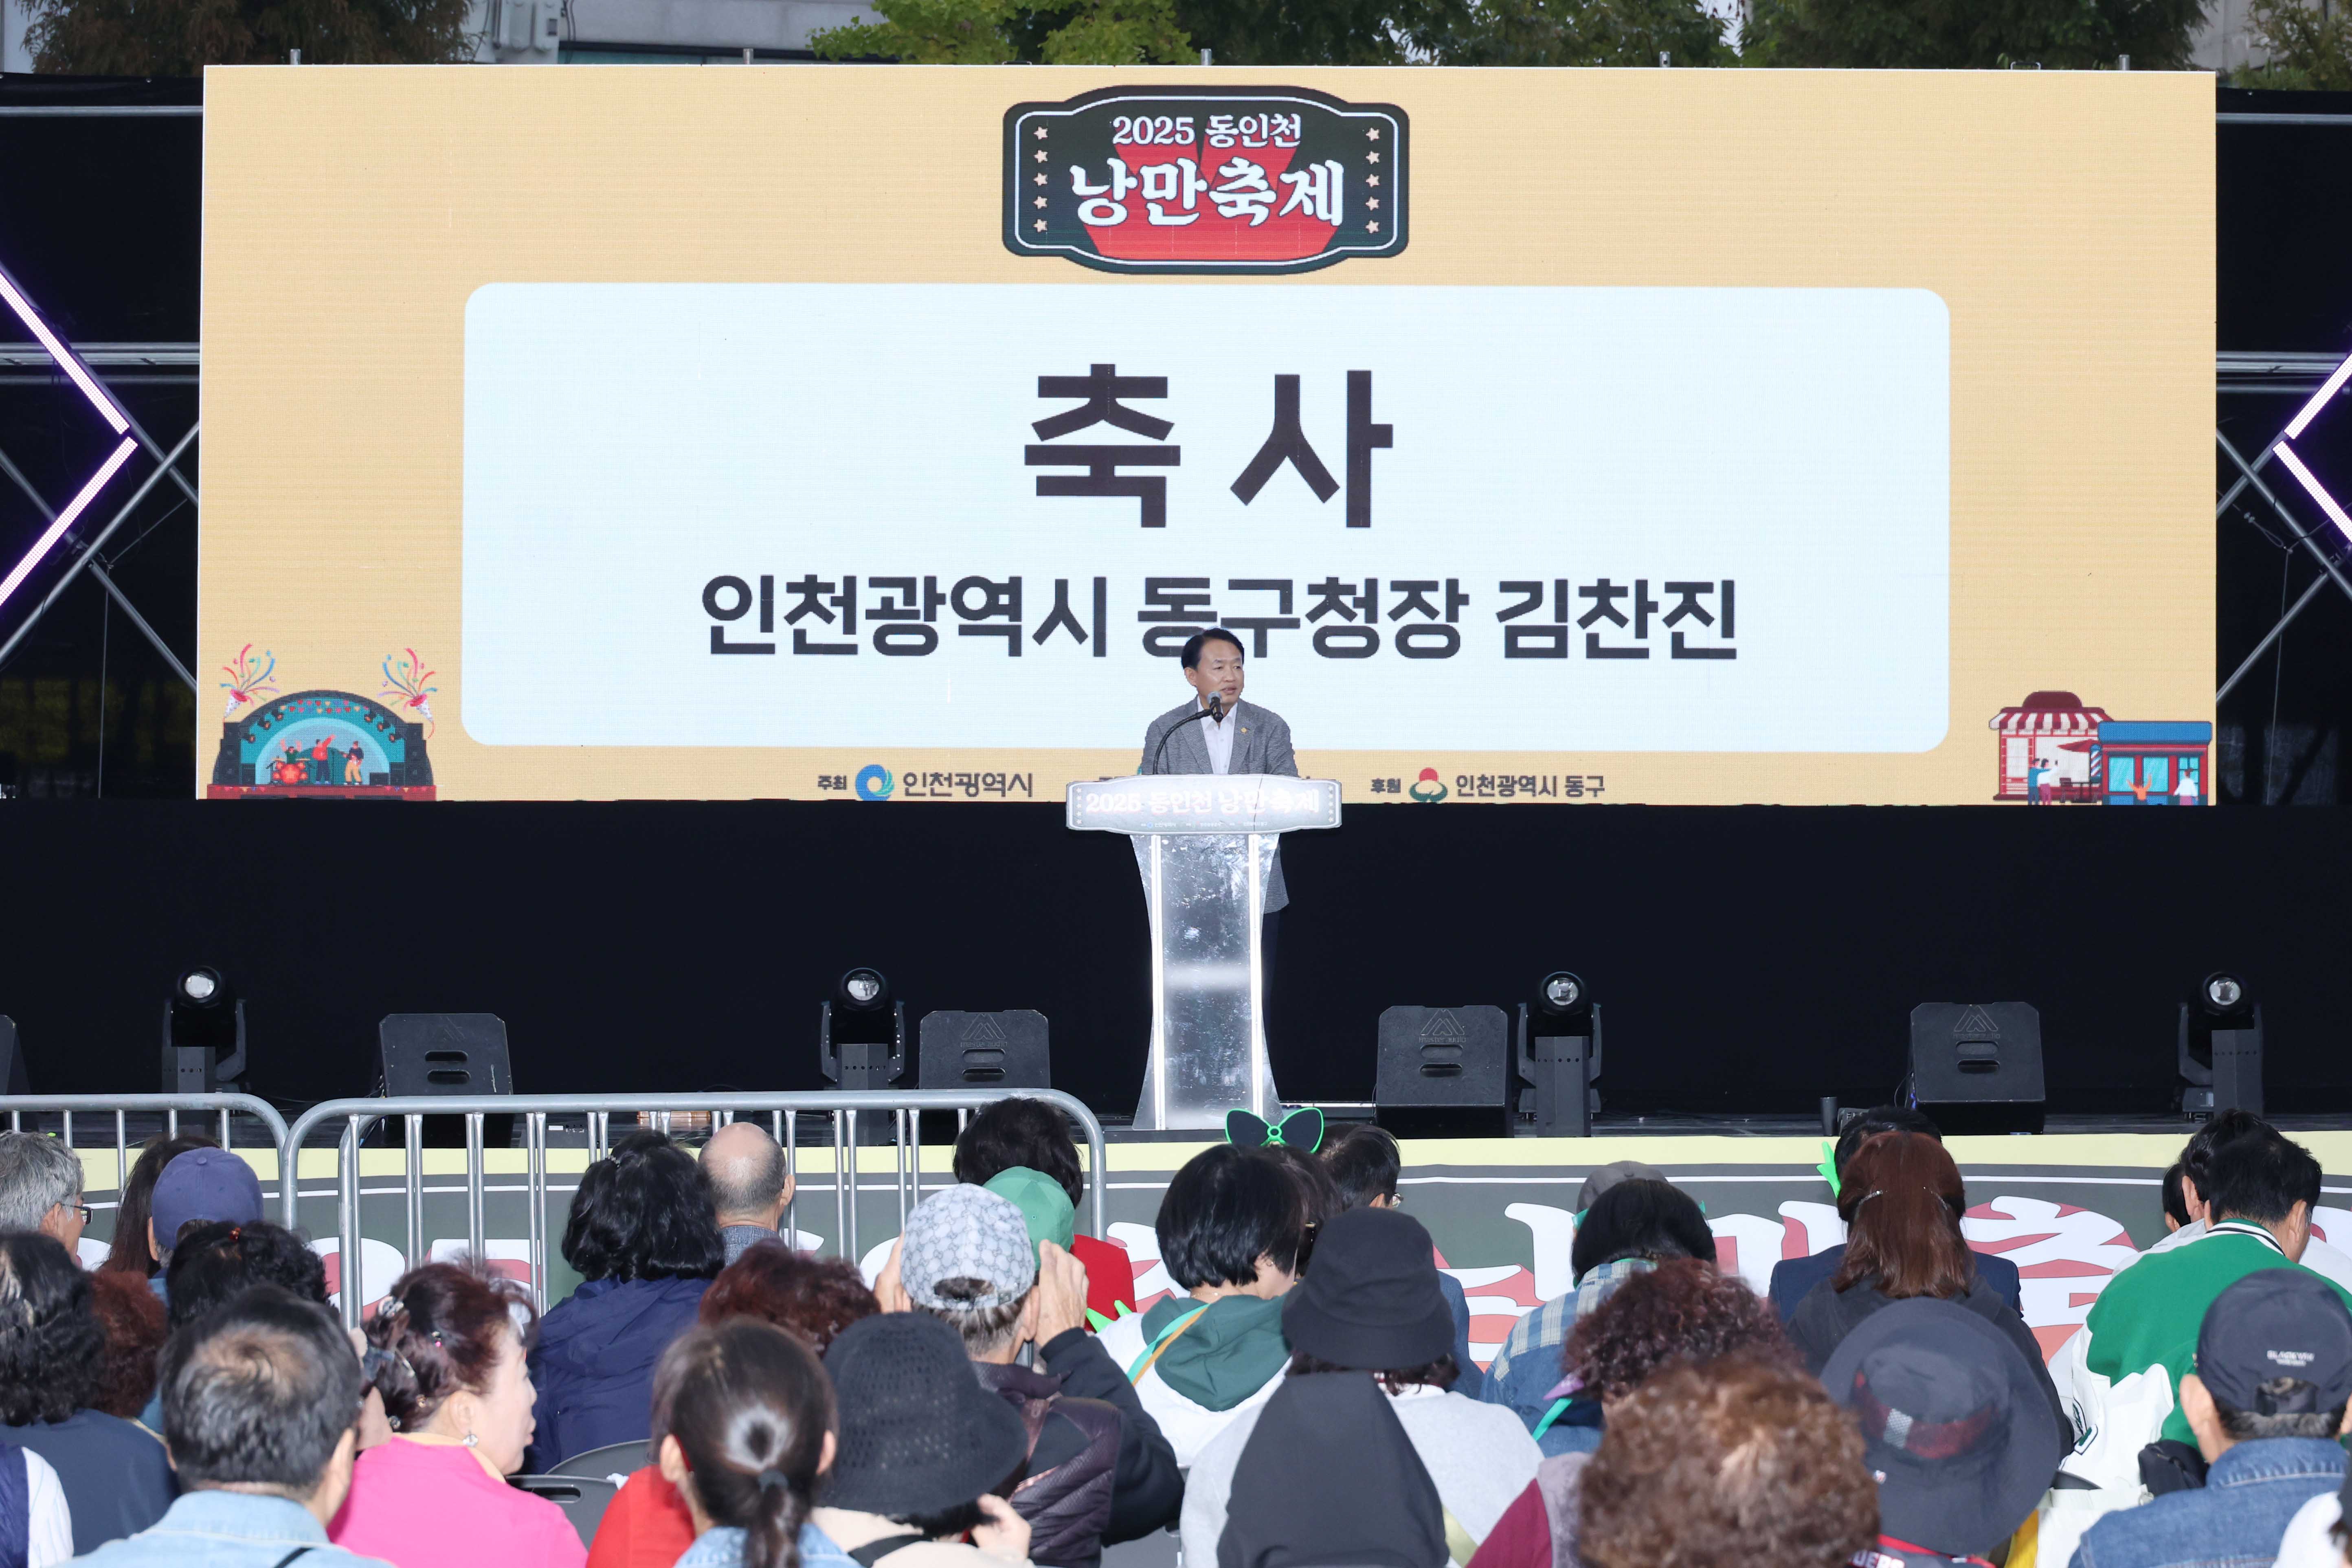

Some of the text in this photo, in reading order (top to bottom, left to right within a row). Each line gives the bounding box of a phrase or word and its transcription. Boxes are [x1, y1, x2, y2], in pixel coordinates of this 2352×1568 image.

[1112, 113, 1301, 148] 2025 동인천
[1069, 156, 1344, 227] 낭만축제
[1024, 363, 1393, 529] 축 사
[702, 574, 1737, 660] 인천광역시 동구청장 김찬진
[818, 772, 1033, 798] 주최 인천광역시
[1370, 774, 1605, 798] 후원 인천광역시 동구
[1086, 793, 1141, 813] 2025
[1149, 791, 1212, 815] 동인천
